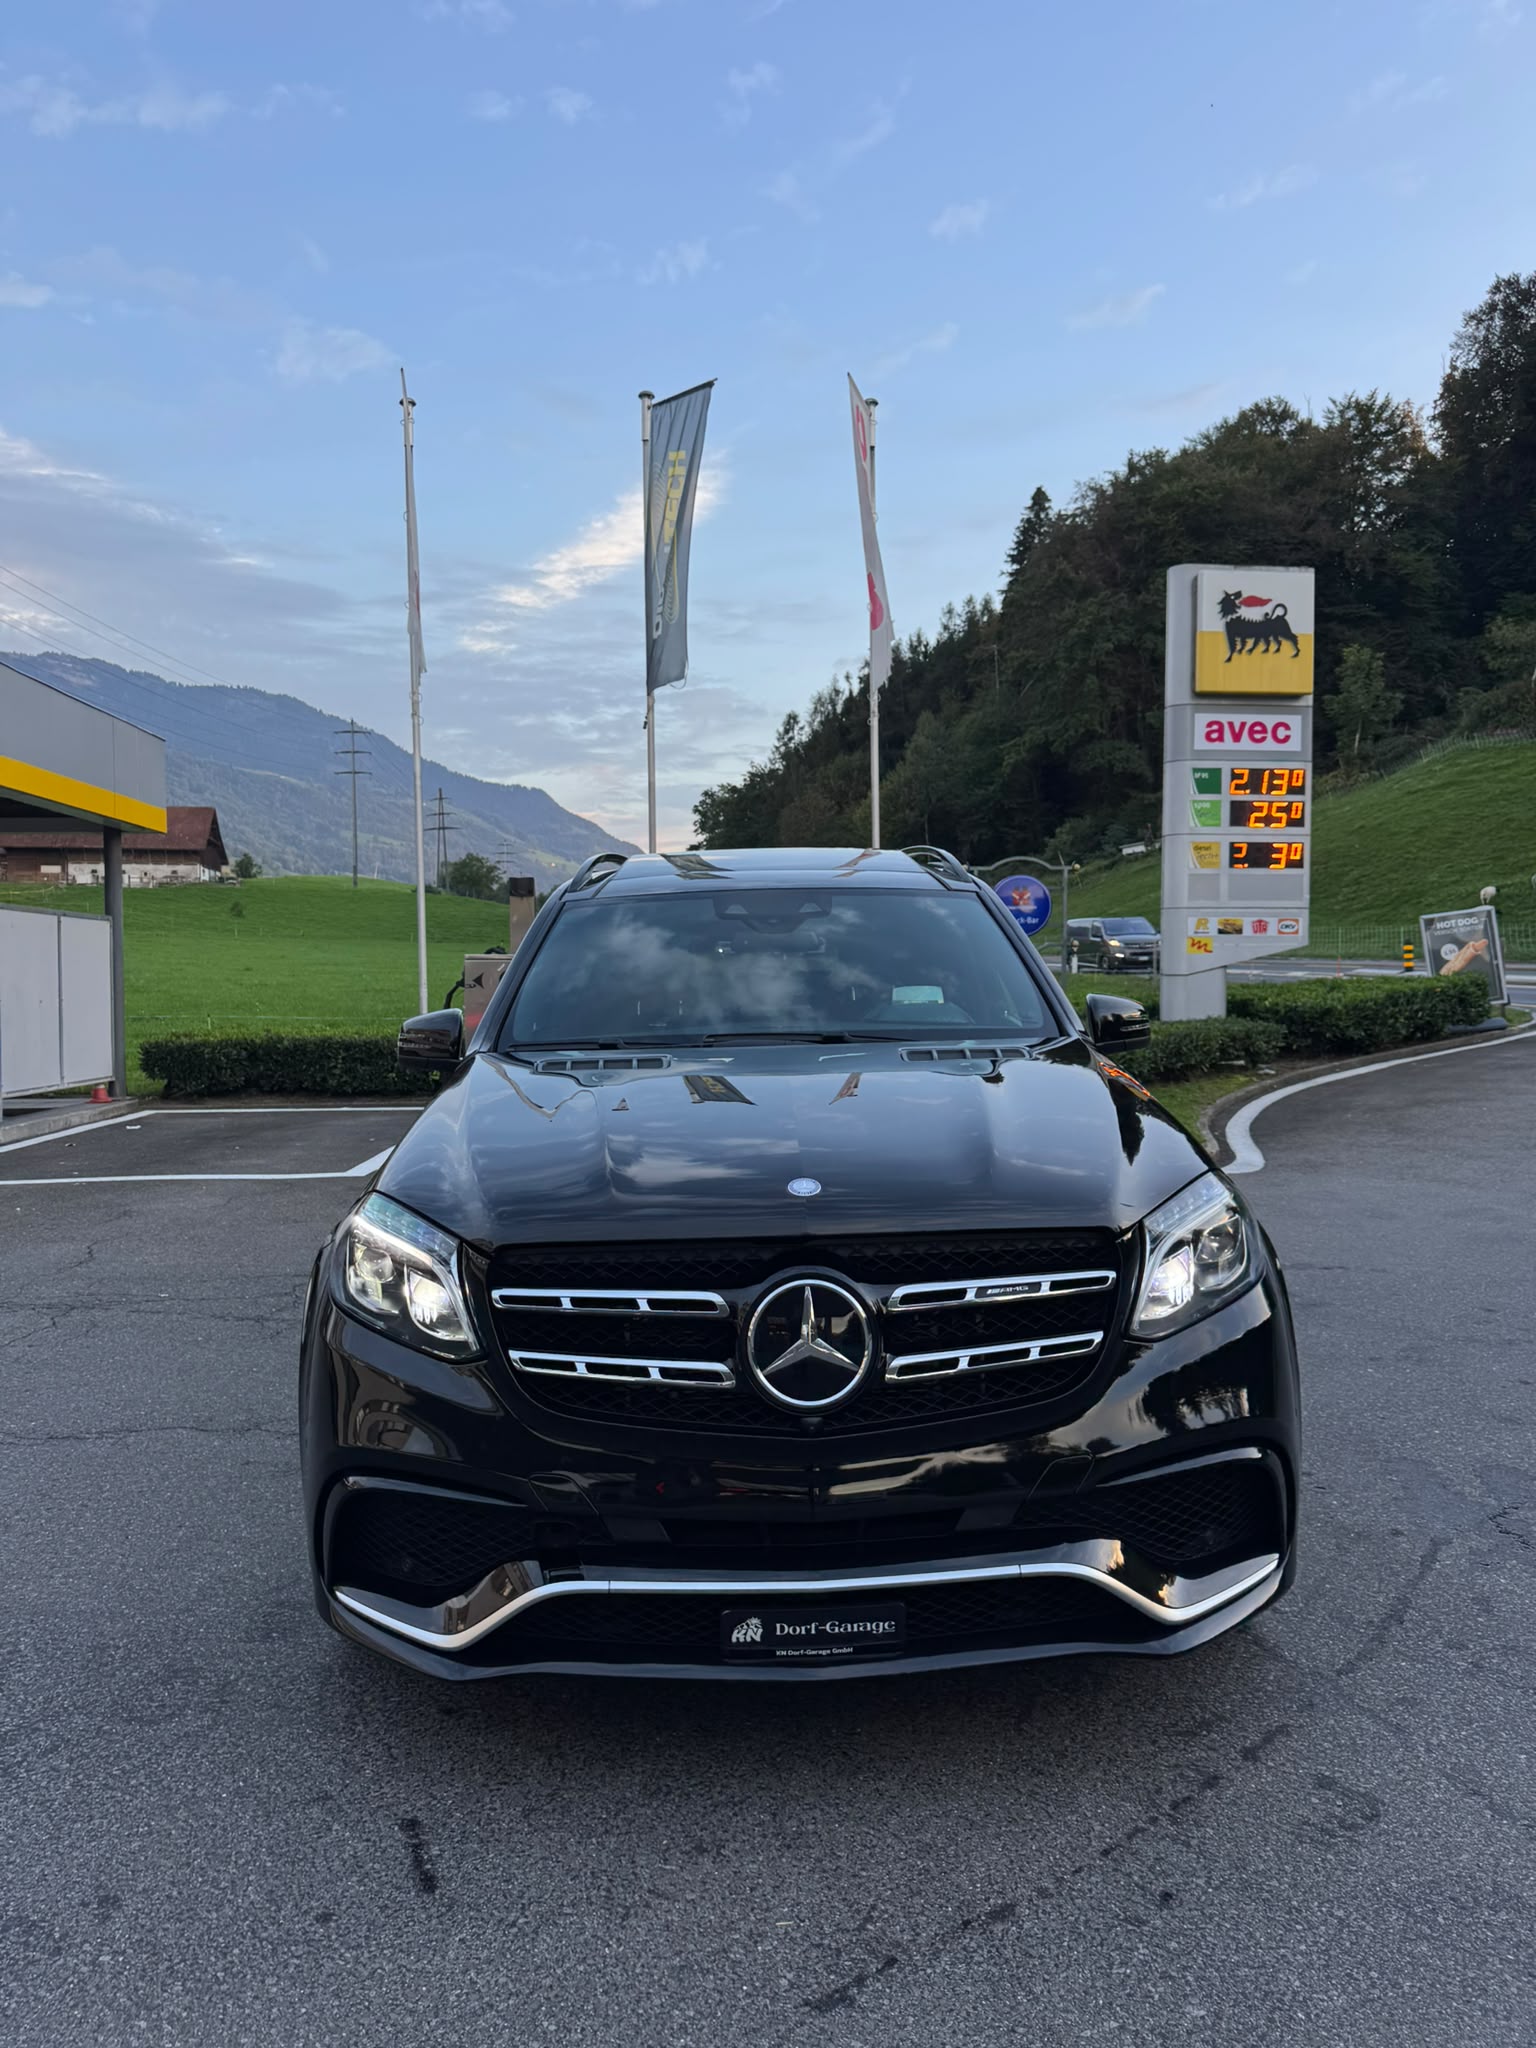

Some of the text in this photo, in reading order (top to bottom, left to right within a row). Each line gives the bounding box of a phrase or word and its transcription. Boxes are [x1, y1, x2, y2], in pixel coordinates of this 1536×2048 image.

[1204, 719, 1292, 744] avec
[1436, 917, 1479, 929] HOT DOG
[1000, 1285, 1029, 1293] AMG
[775, 1621, 895, 1635] Dorf-Garage
[788, 1648, 831, 1656] Dorf-Garage
